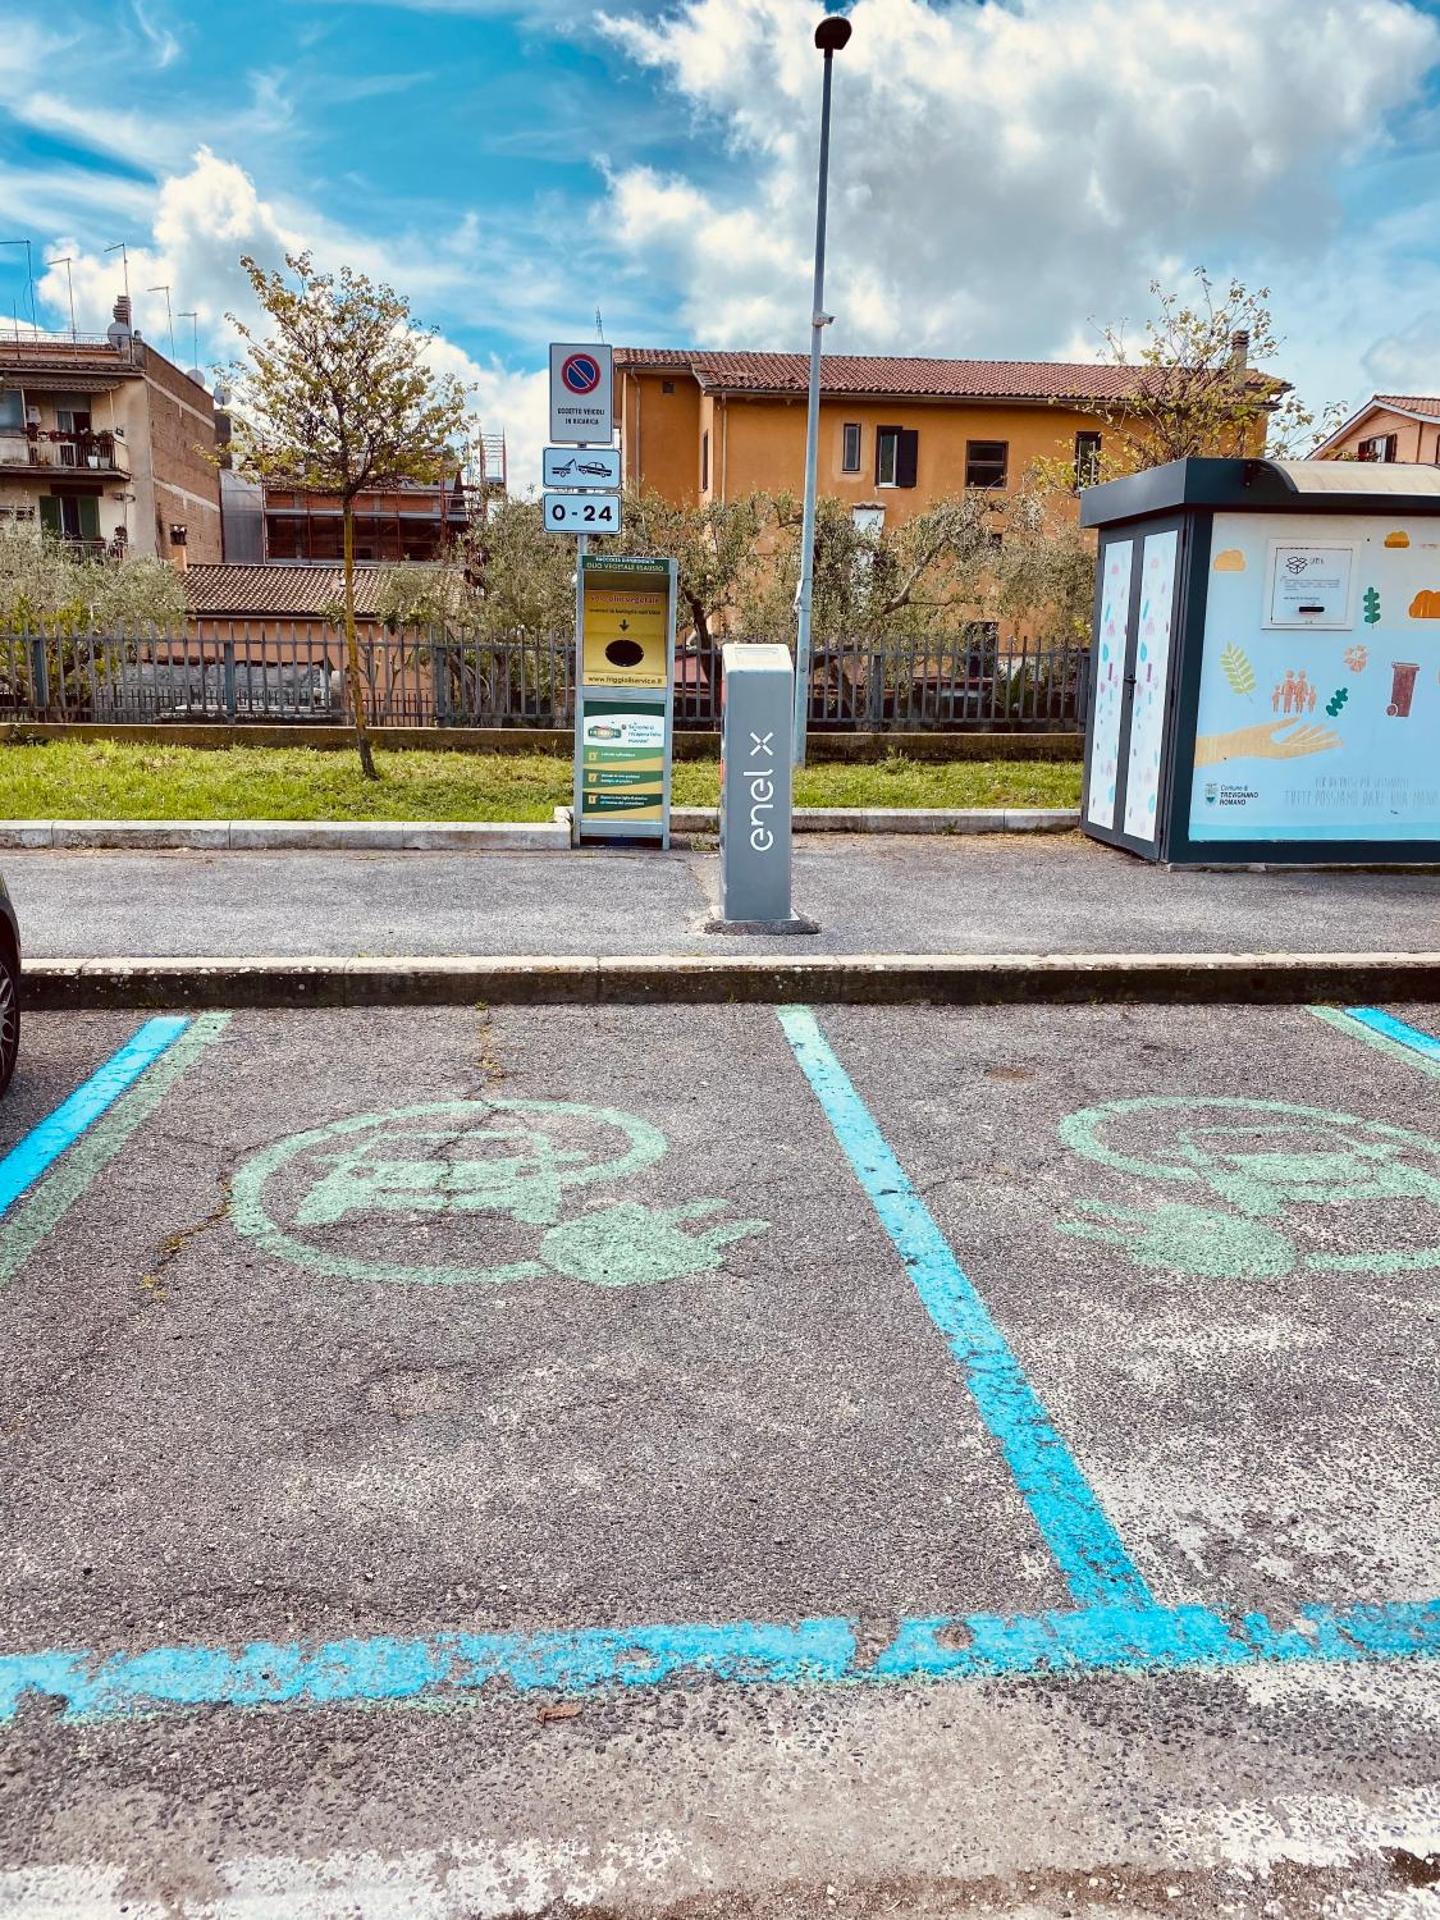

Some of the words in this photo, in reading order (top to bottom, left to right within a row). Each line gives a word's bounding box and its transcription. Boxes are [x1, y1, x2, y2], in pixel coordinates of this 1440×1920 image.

[552, 504, 566, 521] 0
[583, 505, 612, 522] 24
[743, 769, 774, 851] enel
